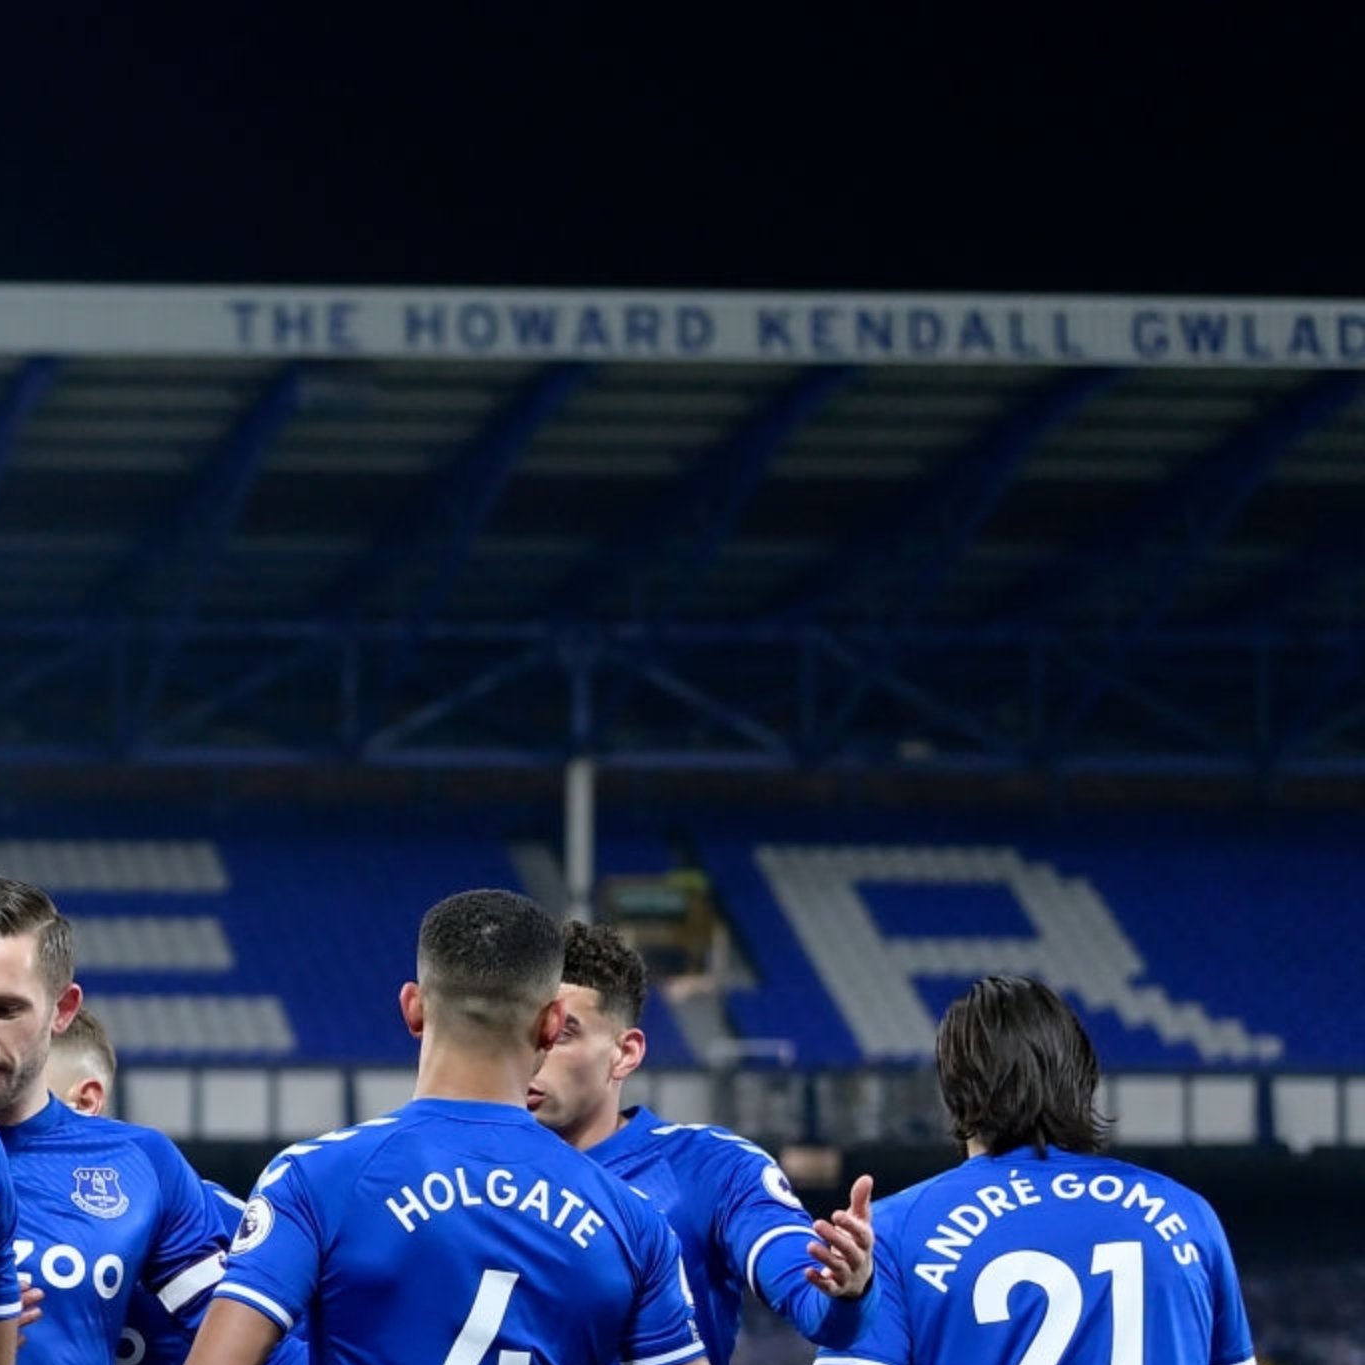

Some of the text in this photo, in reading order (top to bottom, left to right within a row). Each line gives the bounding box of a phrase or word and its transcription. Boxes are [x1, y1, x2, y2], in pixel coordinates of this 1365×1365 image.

[227, 302, 360, 352] THE
[404, 303, 716, 355] HOWARD
[756, 305, 1083, 358] KENDALL
[385, 1167, 605, 1249] HOLGATE
[914, 1169, 1200, 1294] ANDRÉ GOMES
